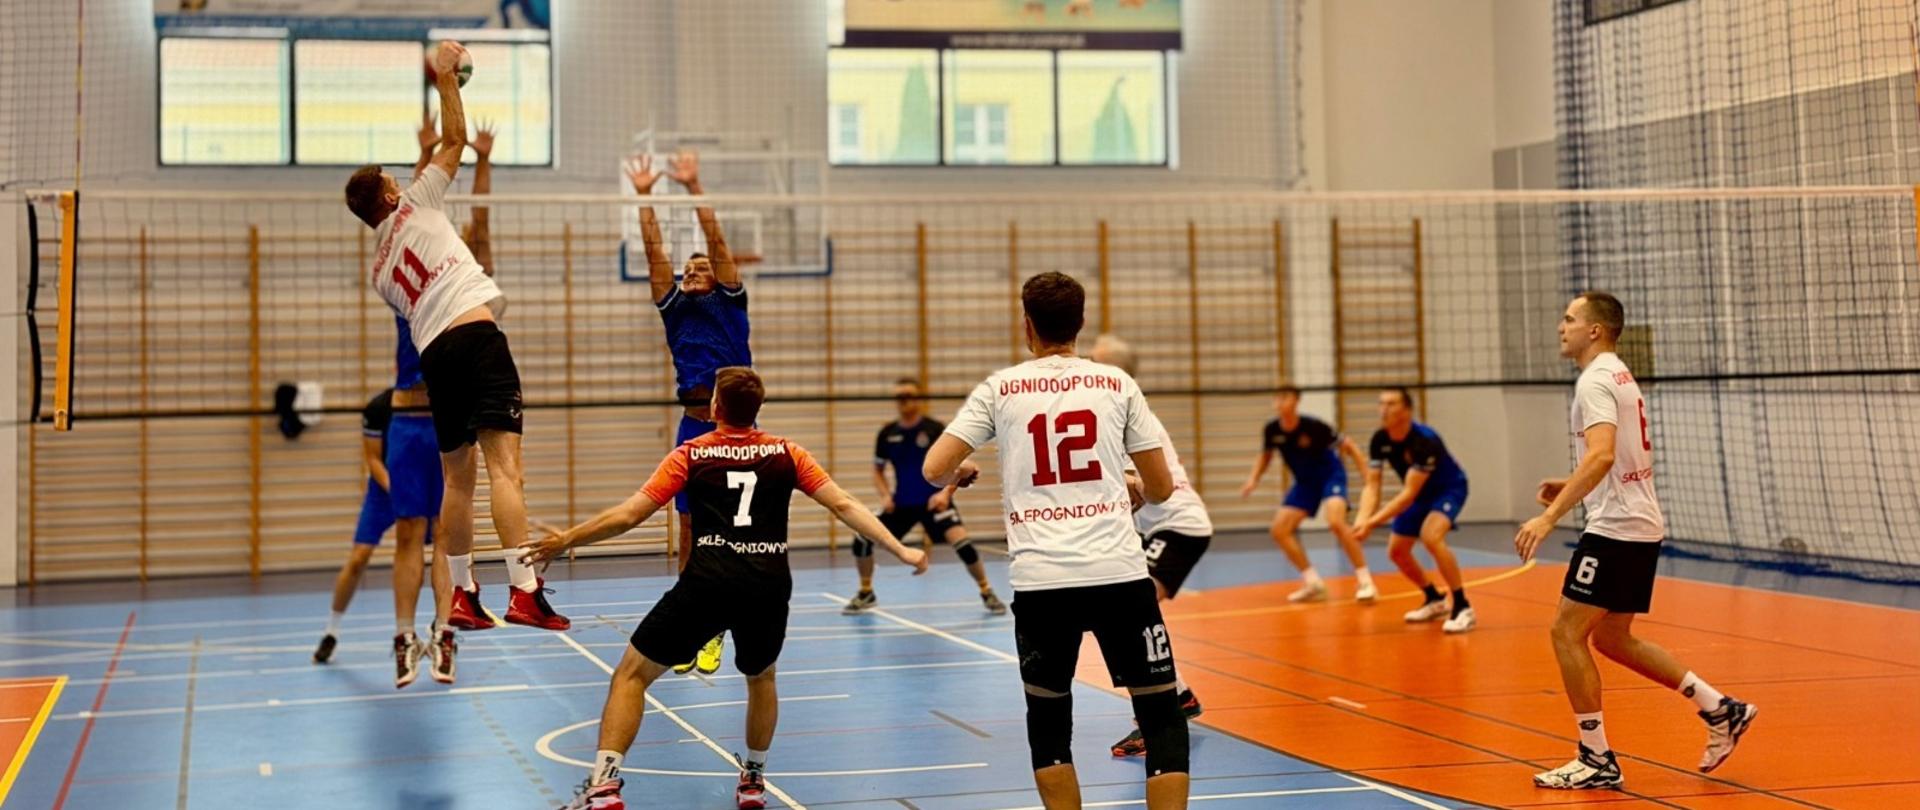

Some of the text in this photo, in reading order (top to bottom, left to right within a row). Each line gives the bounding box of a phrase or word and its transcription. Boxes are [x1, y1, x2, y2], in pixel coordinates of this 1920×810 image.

[393, 246, 429, 306] 11
[1000, 375, 1122, 396] OGNIOODPORNI
[1027, 409, 1102, 487] 12
[726, 471, 758, 527] 7
[1576, 555, 1599, 585] 6
[1142, 624, 1170, 662] 12
